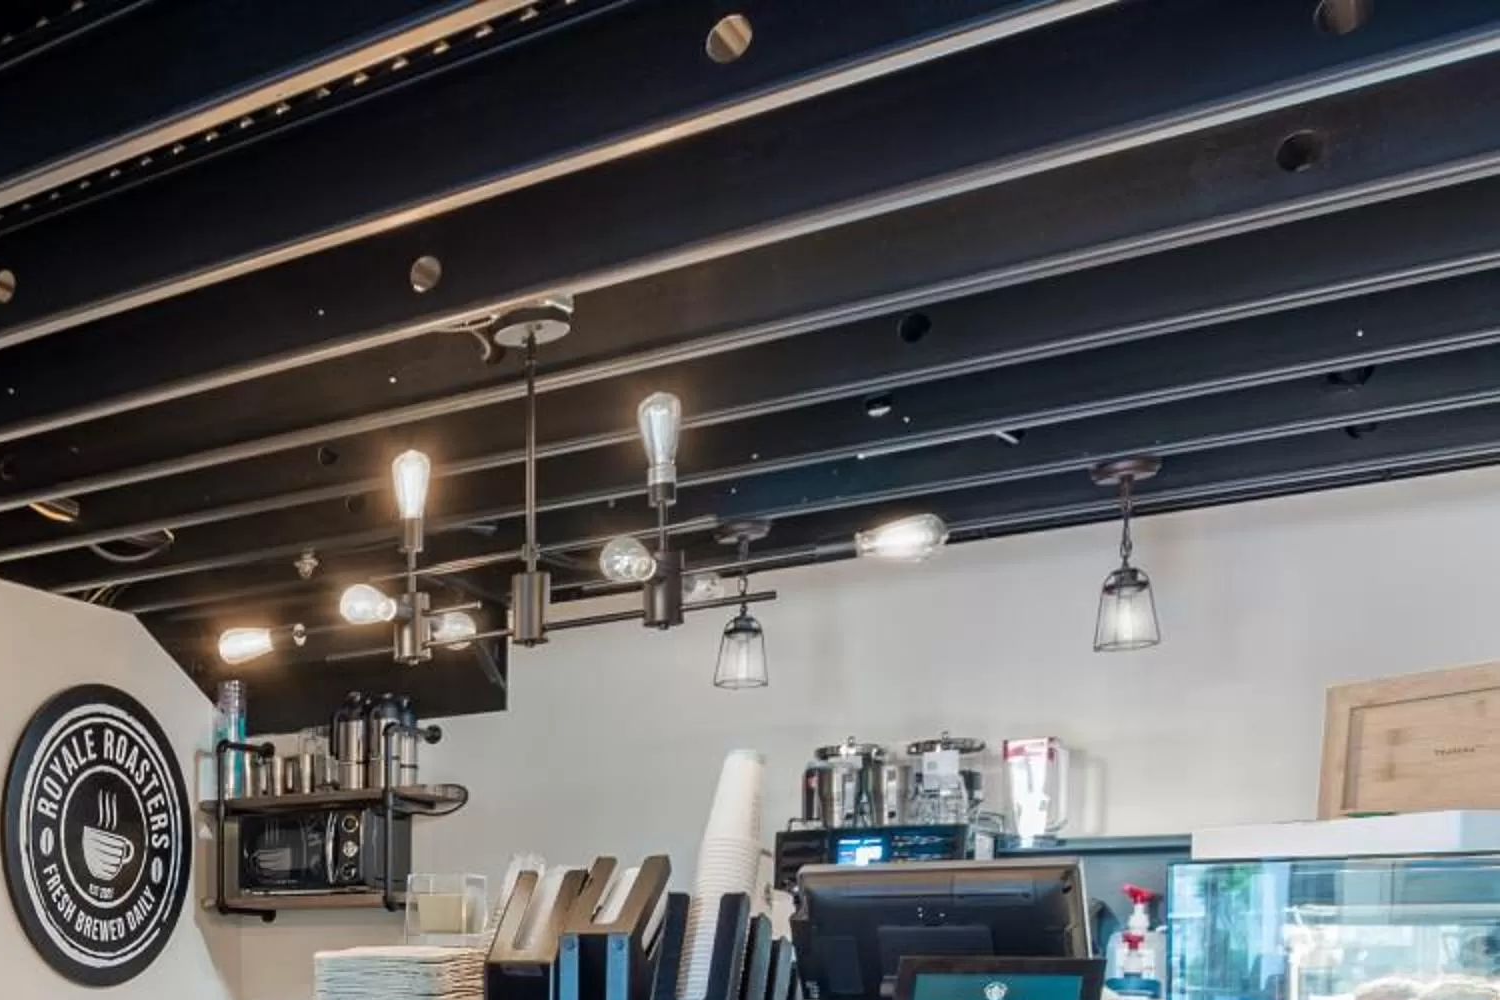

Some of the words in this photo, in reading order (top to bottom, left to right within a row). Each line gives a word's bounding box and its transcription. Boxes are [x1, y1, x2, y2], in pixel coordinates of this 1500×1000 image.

[37, 729, 98, 819] ROYALE
[103, 728, 170, 849] ROASTERS
[43, 863, 75, 923] FRESH
[74, 910, 126, 942] BREWED
[126, 885, 156, 932] DAILY
